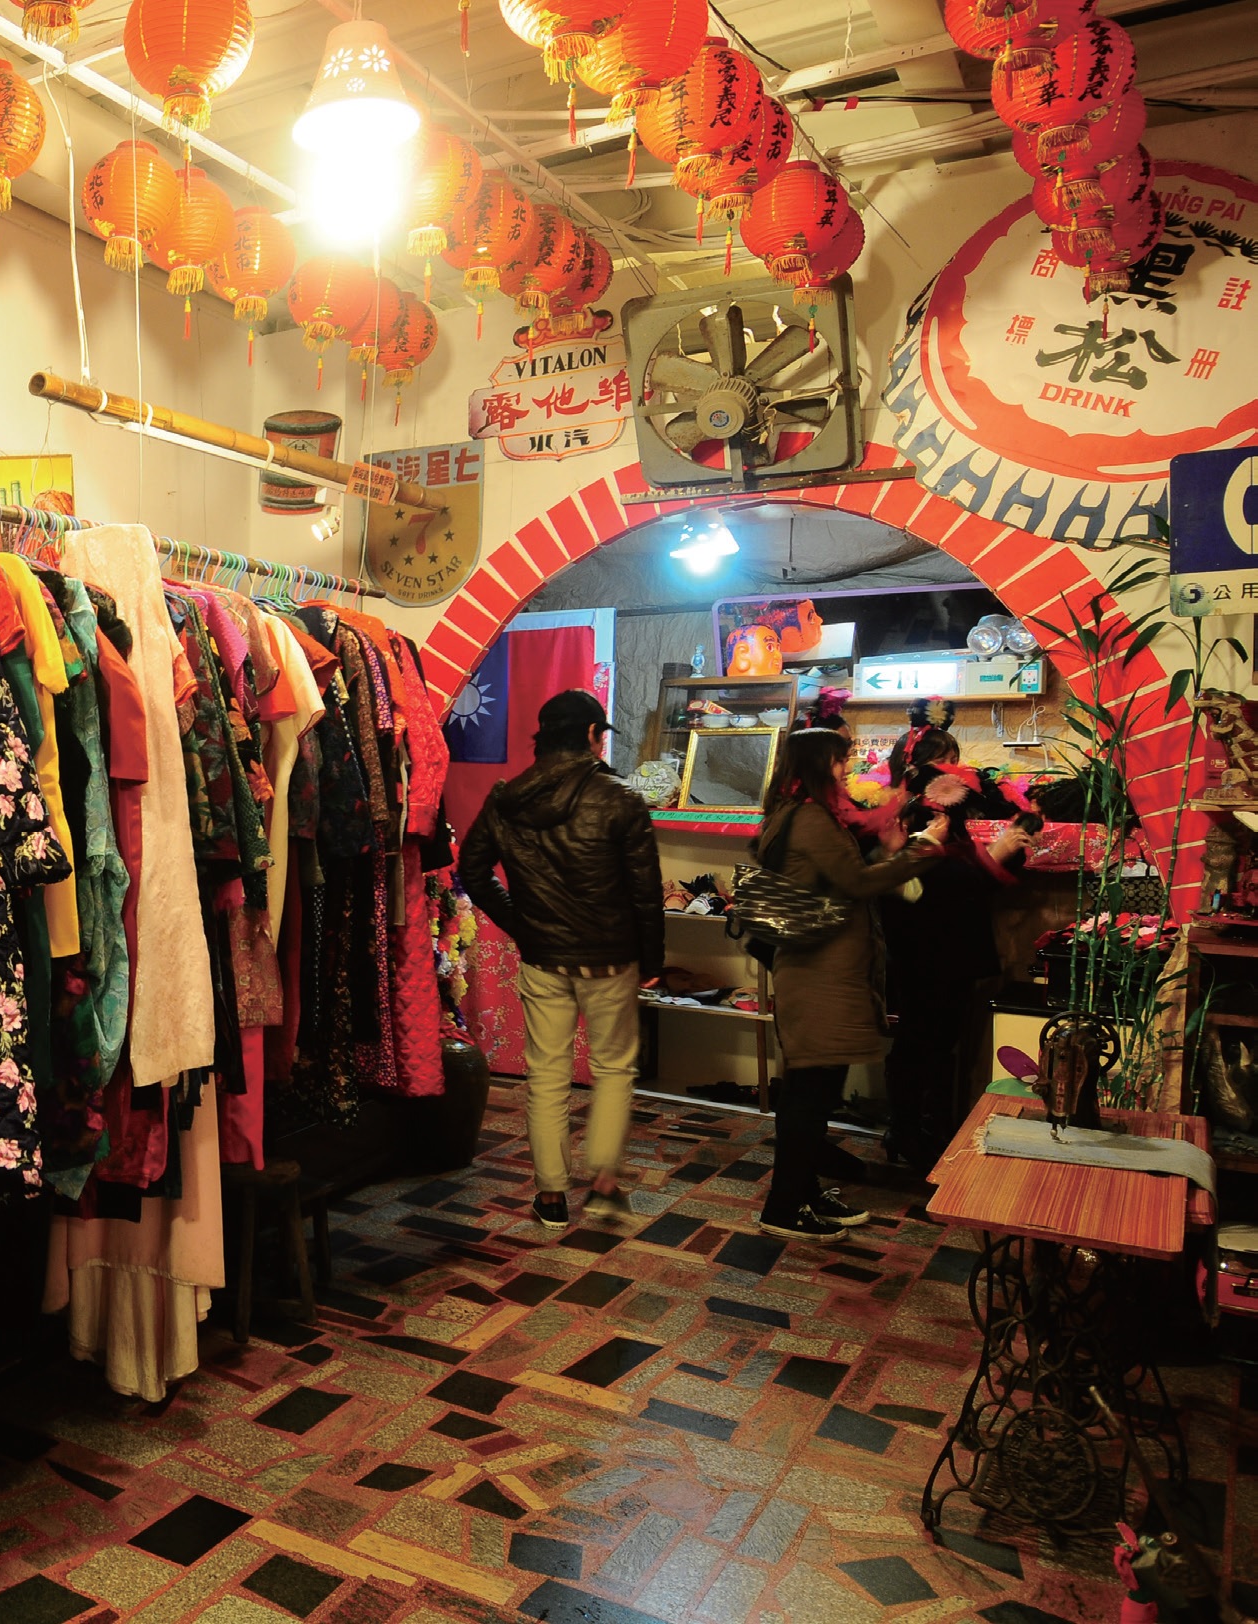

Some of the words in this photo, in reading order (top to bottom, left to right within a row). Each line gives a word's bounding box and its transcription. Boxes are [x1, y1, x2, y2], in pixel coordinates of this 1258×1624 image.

[1078, 20, 1113, 101] 客家義民
[710, 50, 740, 128] 客家義民
[766, 100, 790, 162] 台北市
[508, 188, 527, 244] 台北市
[1155, 191, 1204, 214] UNG
[1206, 199, 1246, 221] PAI
[514, 345, 607, 379] VITALON
[1038, 383, 1137, 418] DRINK
[407, 513, 436, 554] 7
[380, 560, 423, 589] SEVEN
[426, 555, 463, 586] STAR
[397, 589, 416, 599] SOFT
[418, 585, 444, 599] DRINKS
